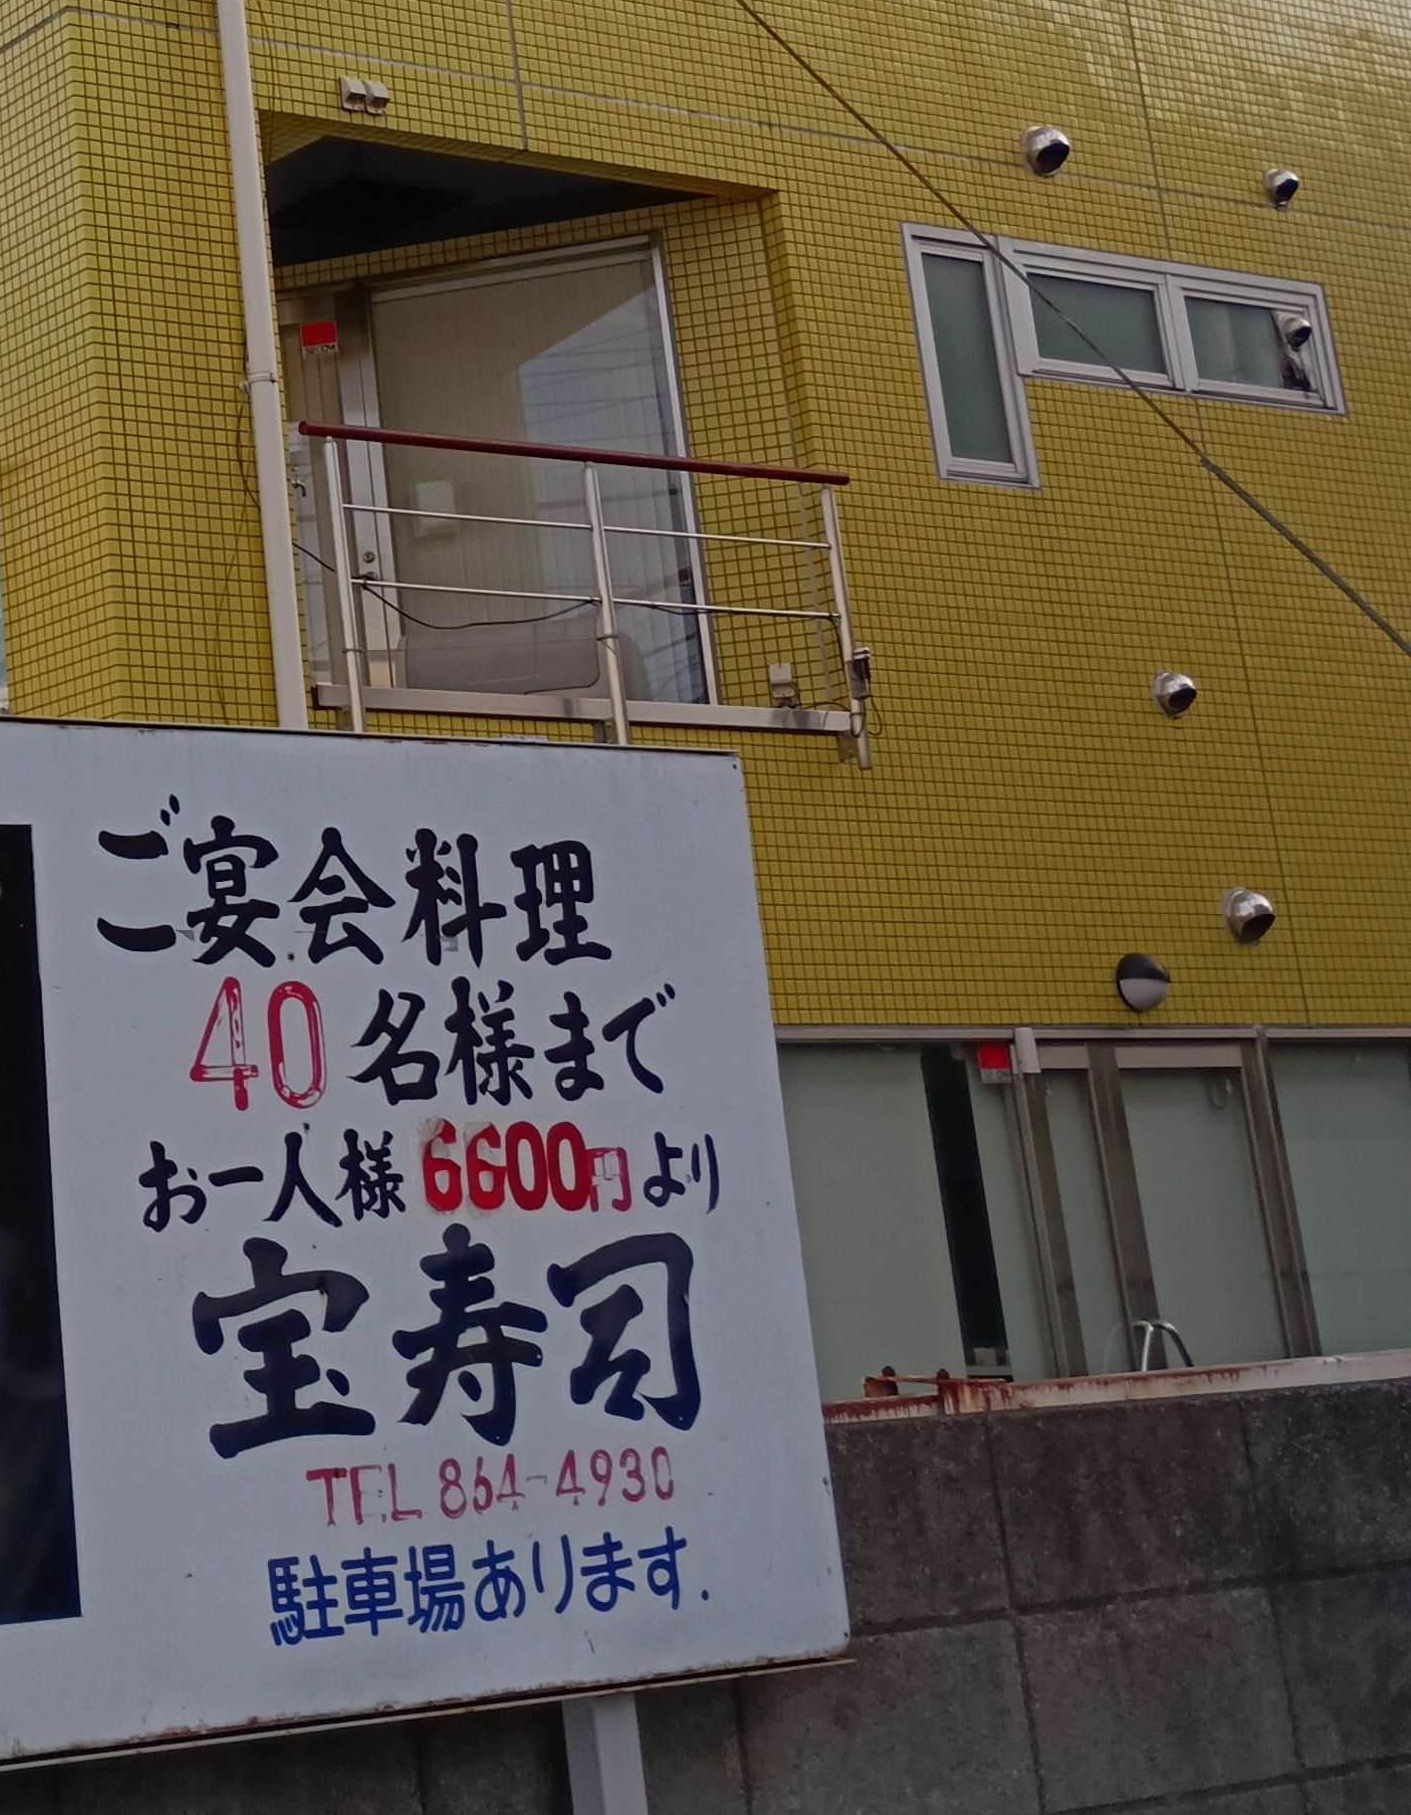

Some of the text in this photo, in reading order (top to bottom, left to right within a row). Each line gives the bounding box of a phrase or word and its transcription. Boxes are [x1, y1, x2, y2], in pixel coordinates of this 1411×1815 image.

[97, 794, 612, 968] ご宴会料理
[192, 1222, 702, 1459] 宝寿司
[305, 1463, 423, 1527] TEL
